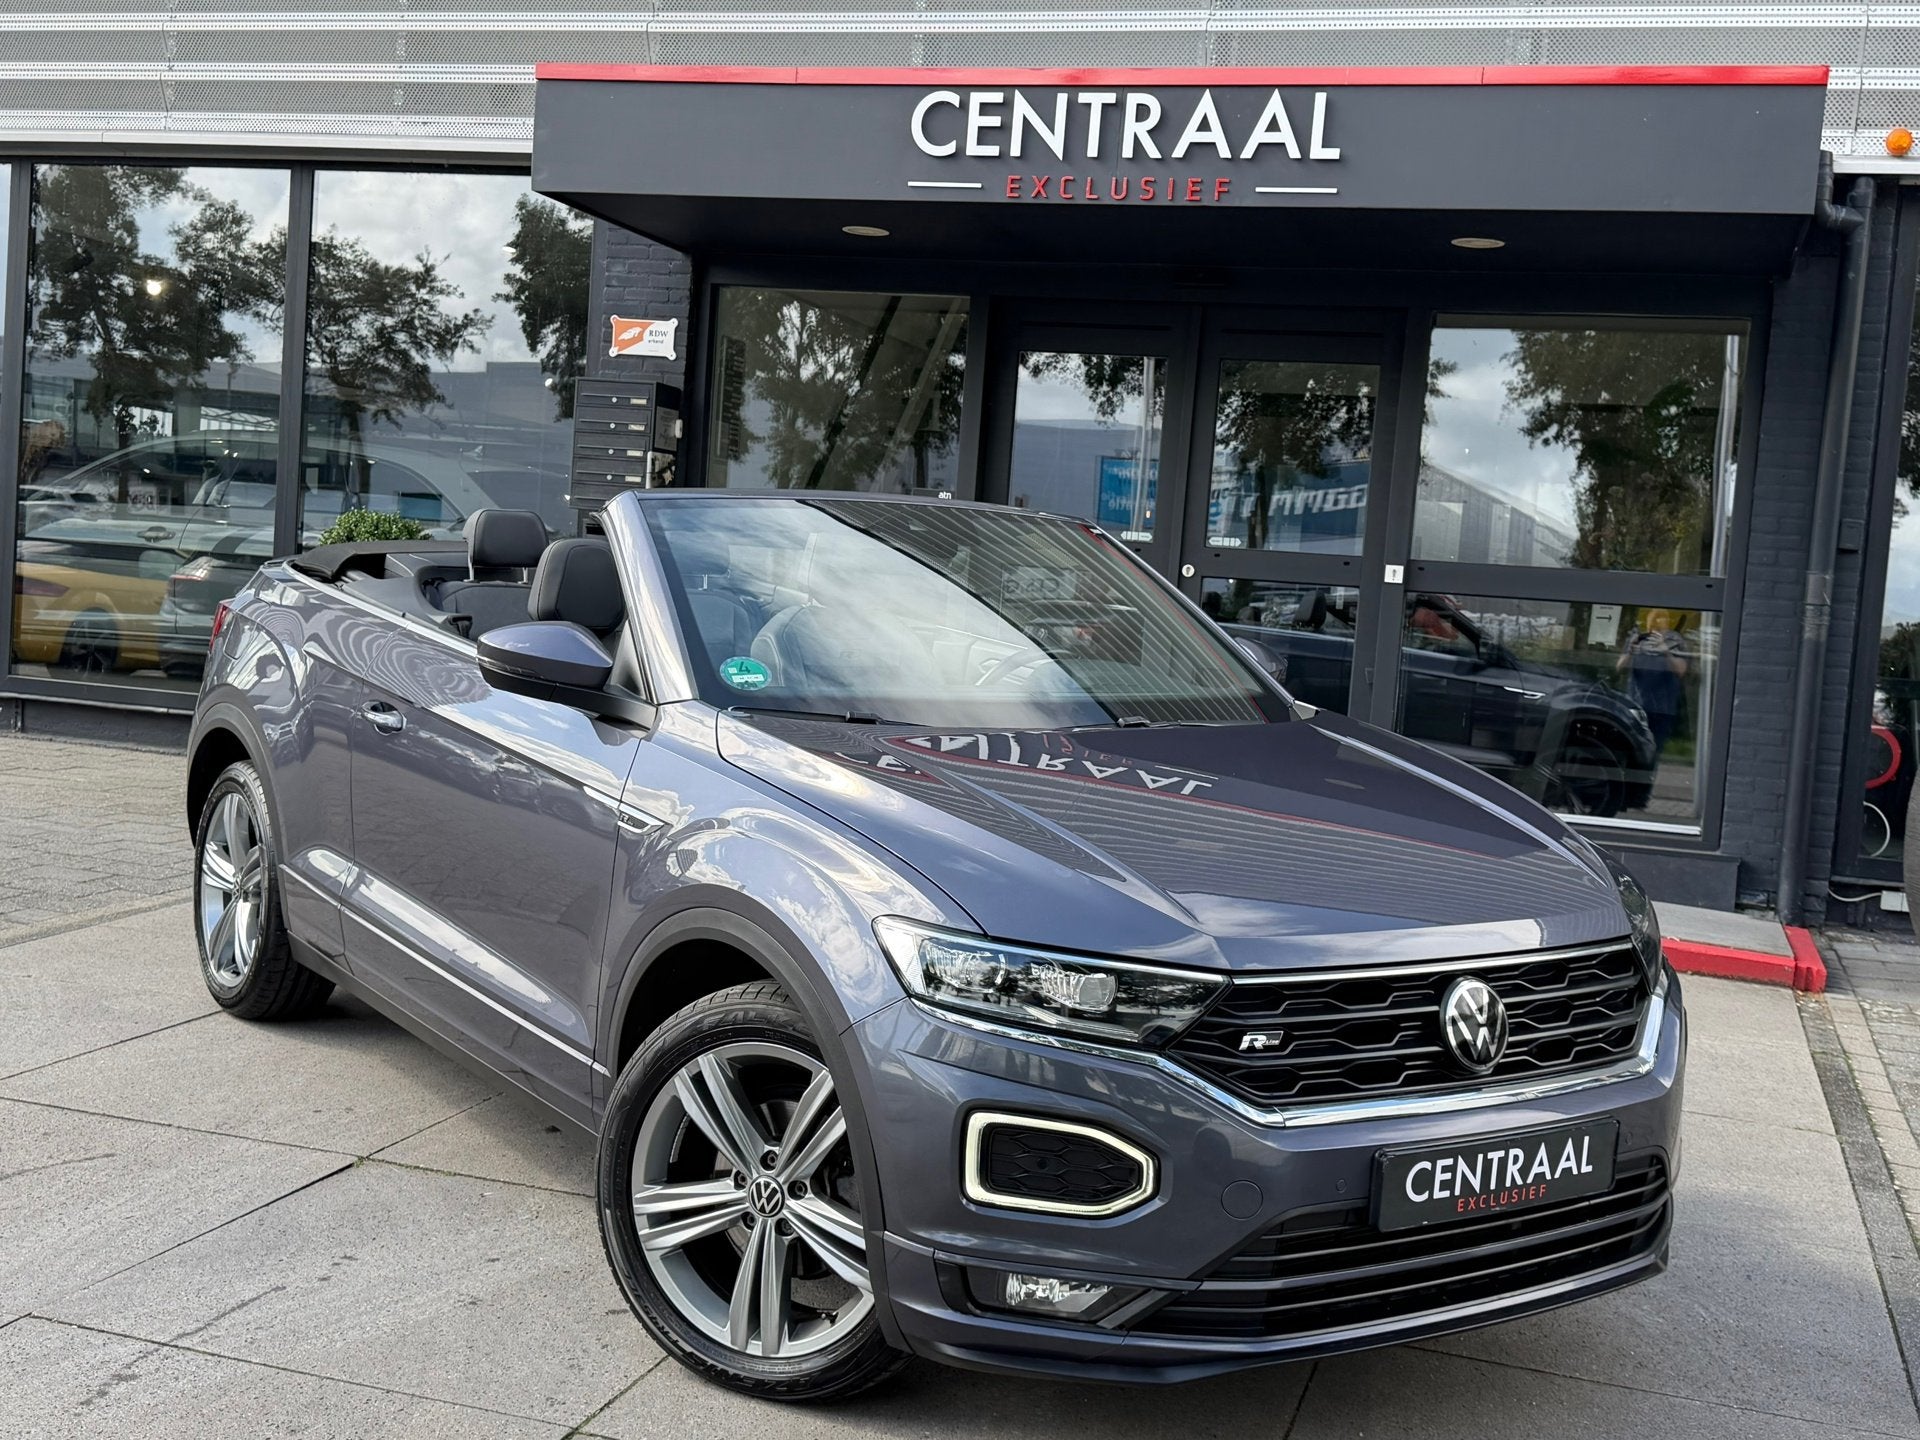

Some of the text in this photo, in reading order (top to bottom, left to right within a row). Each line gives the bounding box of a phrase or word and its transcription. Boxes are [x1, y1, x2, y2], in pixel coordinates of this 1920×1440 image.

[910, 88, 1341, 161] CENTRAAL
[1006, 175, 1232, 201] EXCLUSIEF
[739, 661, 751, 674] 4
[1405, 1136, 1593, 1202] CENTRAAL
[1457, 1184, 1548, 1213] EXCLUSIEF
